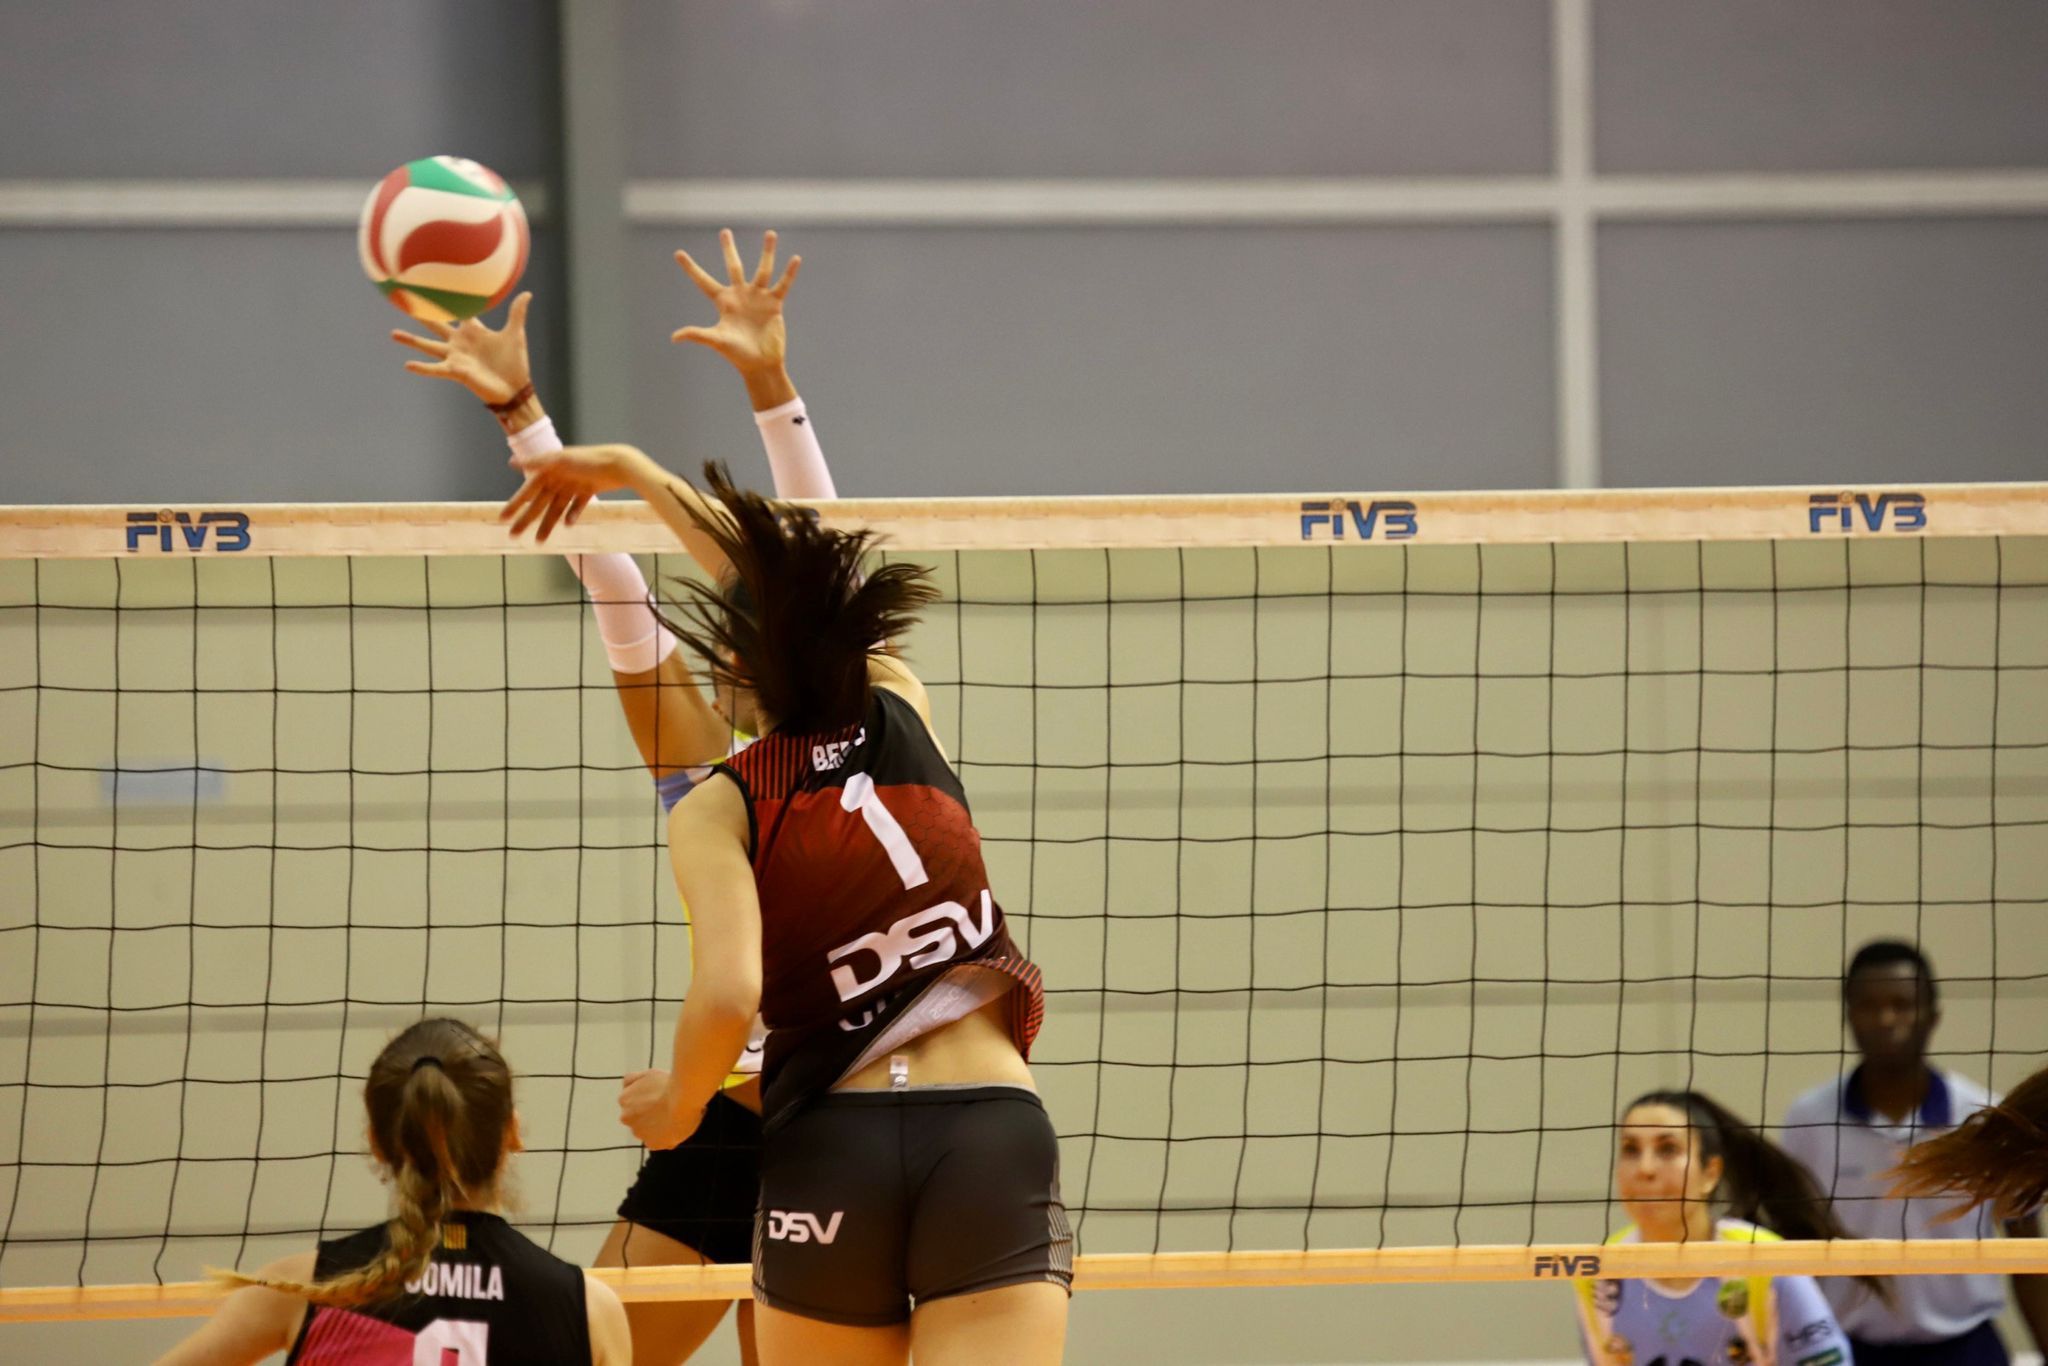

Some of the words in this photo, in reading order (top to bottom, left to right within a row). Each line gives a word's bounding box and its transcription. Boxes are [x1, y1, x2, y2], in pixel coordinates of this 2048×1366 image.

[840, 771, 929, 891] 1
[826, 889, 994, 1003] DSV
[768, 1210, 844, 1245] DSV
